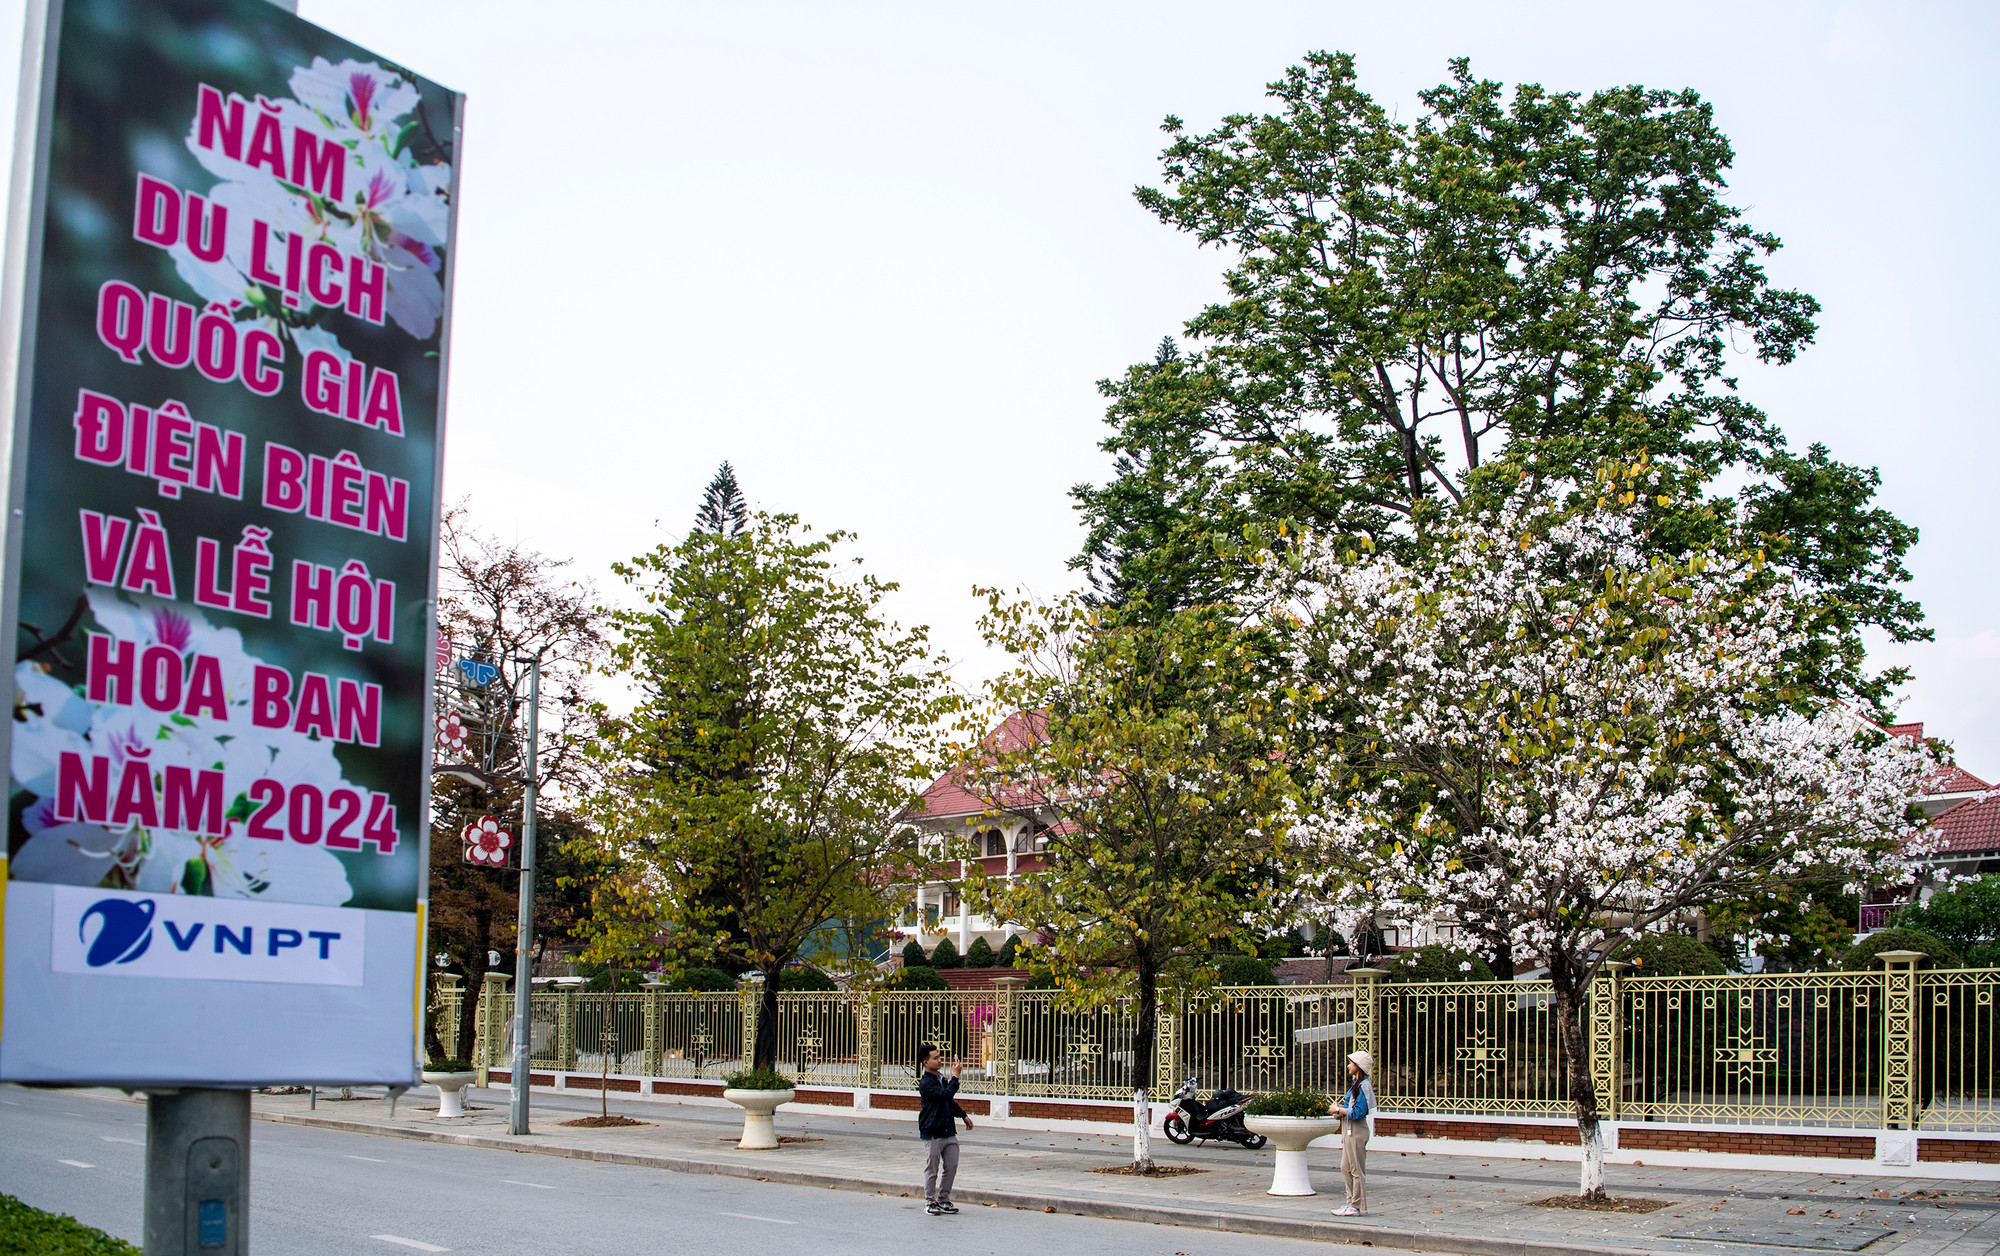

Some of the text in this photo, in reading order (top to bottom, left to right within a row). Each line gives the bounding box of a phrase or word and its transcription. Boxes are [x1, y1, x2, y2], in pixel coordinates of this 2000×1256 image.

[198, 84, 346, 202] NĂM
[134, 174, 385, 323] DU LỊCH
[97, 282, 402, 435] QUỐC GIA
[75, 390, 407, 540] ĐIỆN BIÊN
[80, 509, 393, 650] VÀ LỄ HỘI
[89, 634, 380, 746] HOA BAN
[57, 744, 398, 854] NĂM 2024
[162, 920, 342, 960] VNPT
